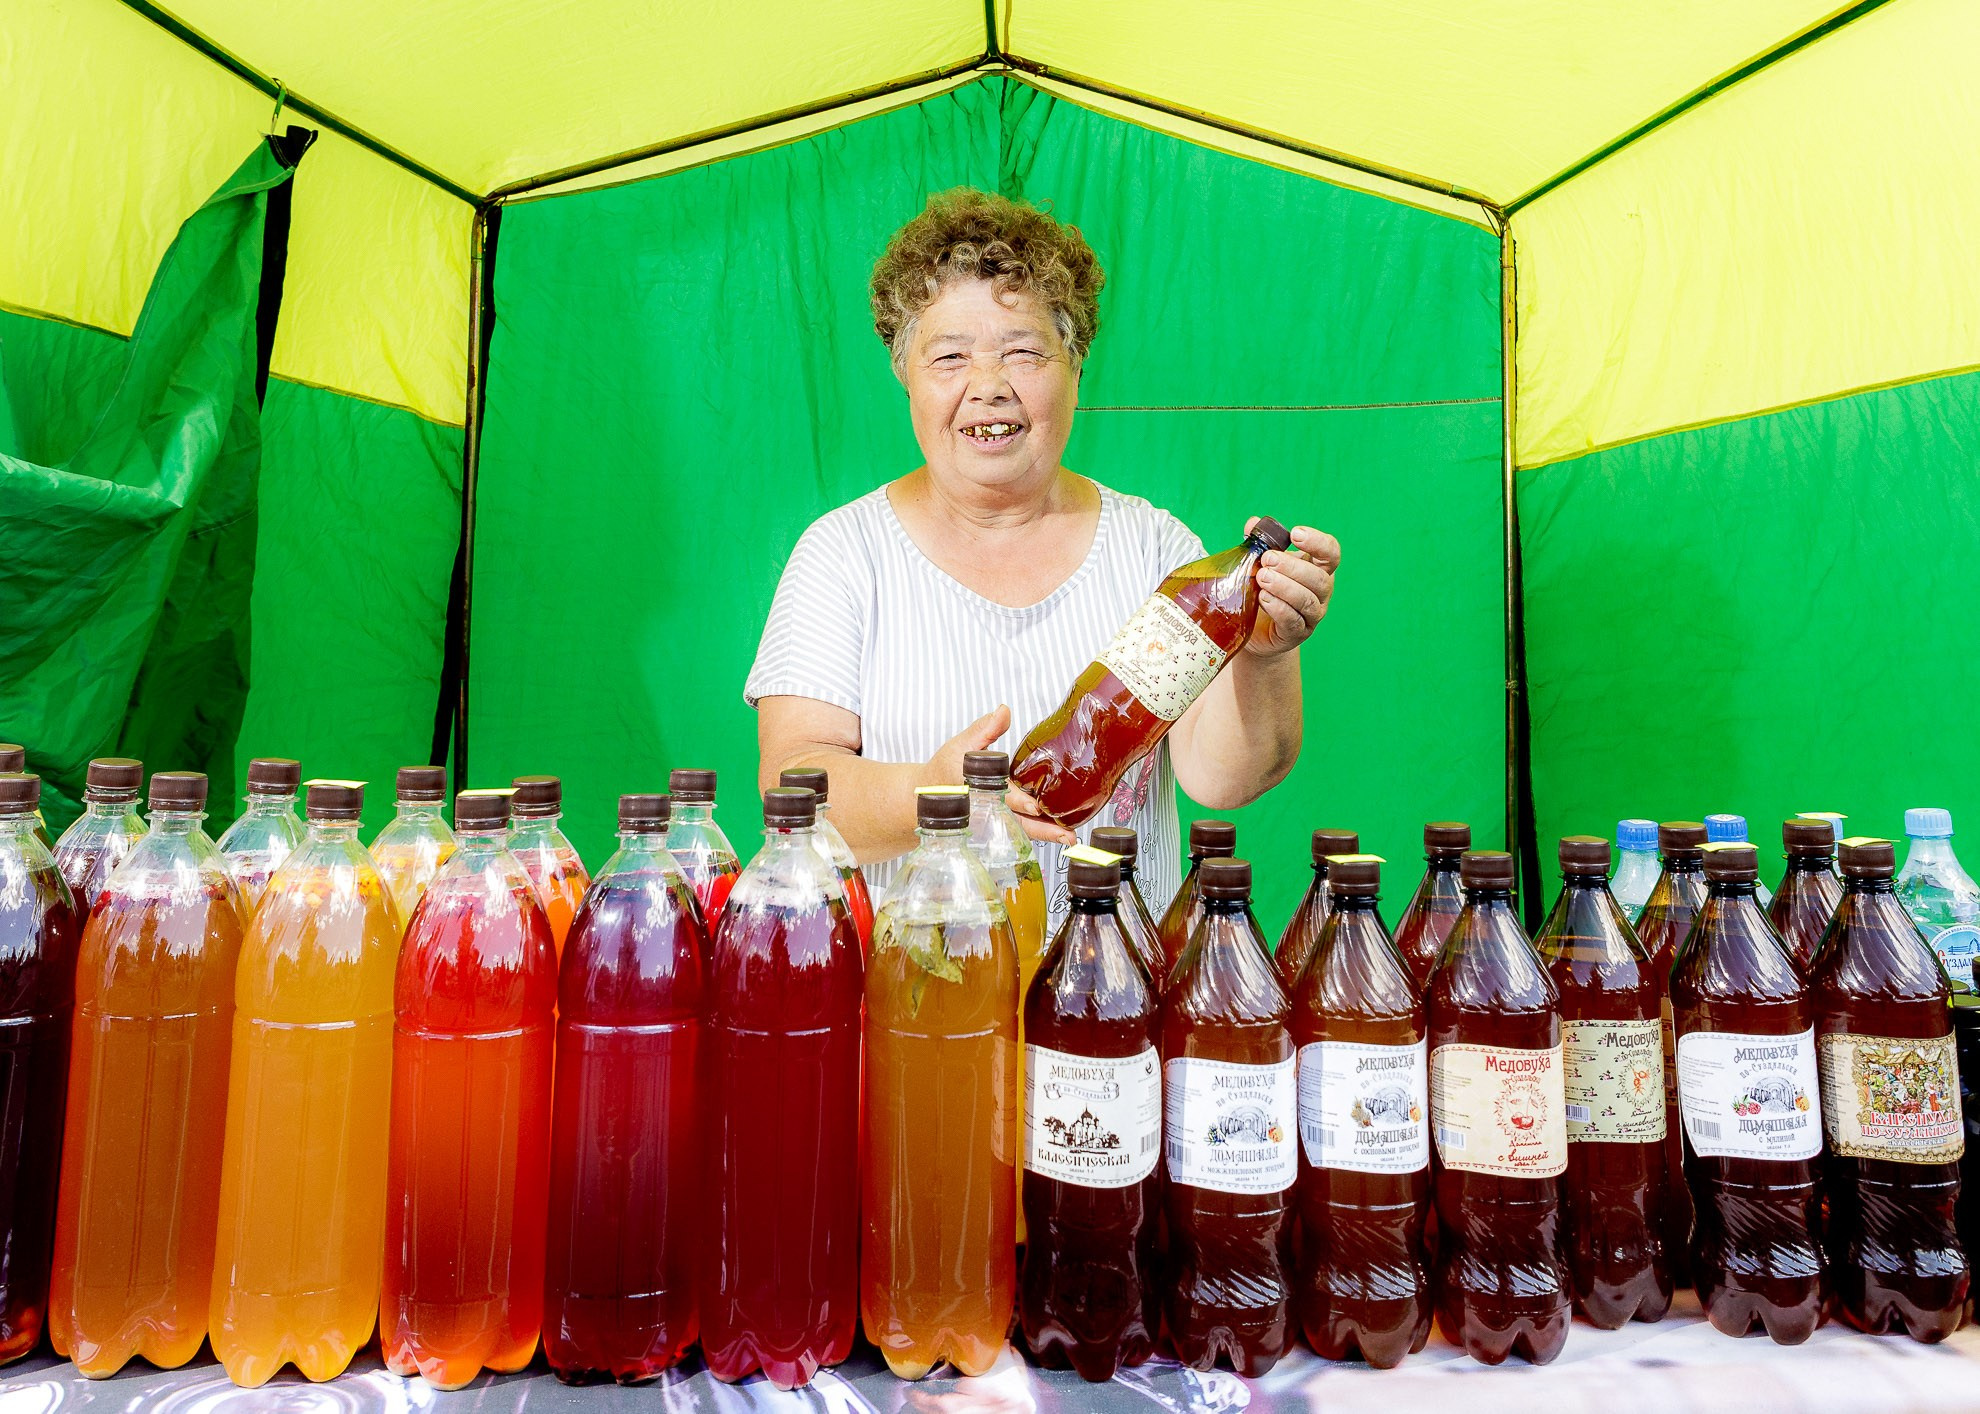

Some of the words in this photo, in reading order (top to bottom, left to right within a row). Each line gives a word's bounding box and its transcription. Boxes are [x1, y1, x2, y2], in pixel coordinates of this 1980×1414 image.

[1155, 605, 1198, 645] Медовуха
[1606, 1029, 1659, 1048] Медовуха
[1356, 1053, 1415, 1073] МЕДОВУХА
[1734, 1044, 1798, 1063] МЕДОВУХА
[1049, 1064, 1115, 1083] МЕДОВУХА
[1485, 1056, 1551, 1074] Медовуха
[1212, 1073, 1276, 1091] МЕДОВУХА
[1739, 1114, 1807, 1135] ДОМАШНЯЯ
[1355, 1125, 1419, 1147] ДОМАШНЯЯ
[1038, 1148, 1130, 1167] КЛАССИЧЕСКАЯ
[1210, 1146, 1279, 1166] ДОМАШНЯЯ
